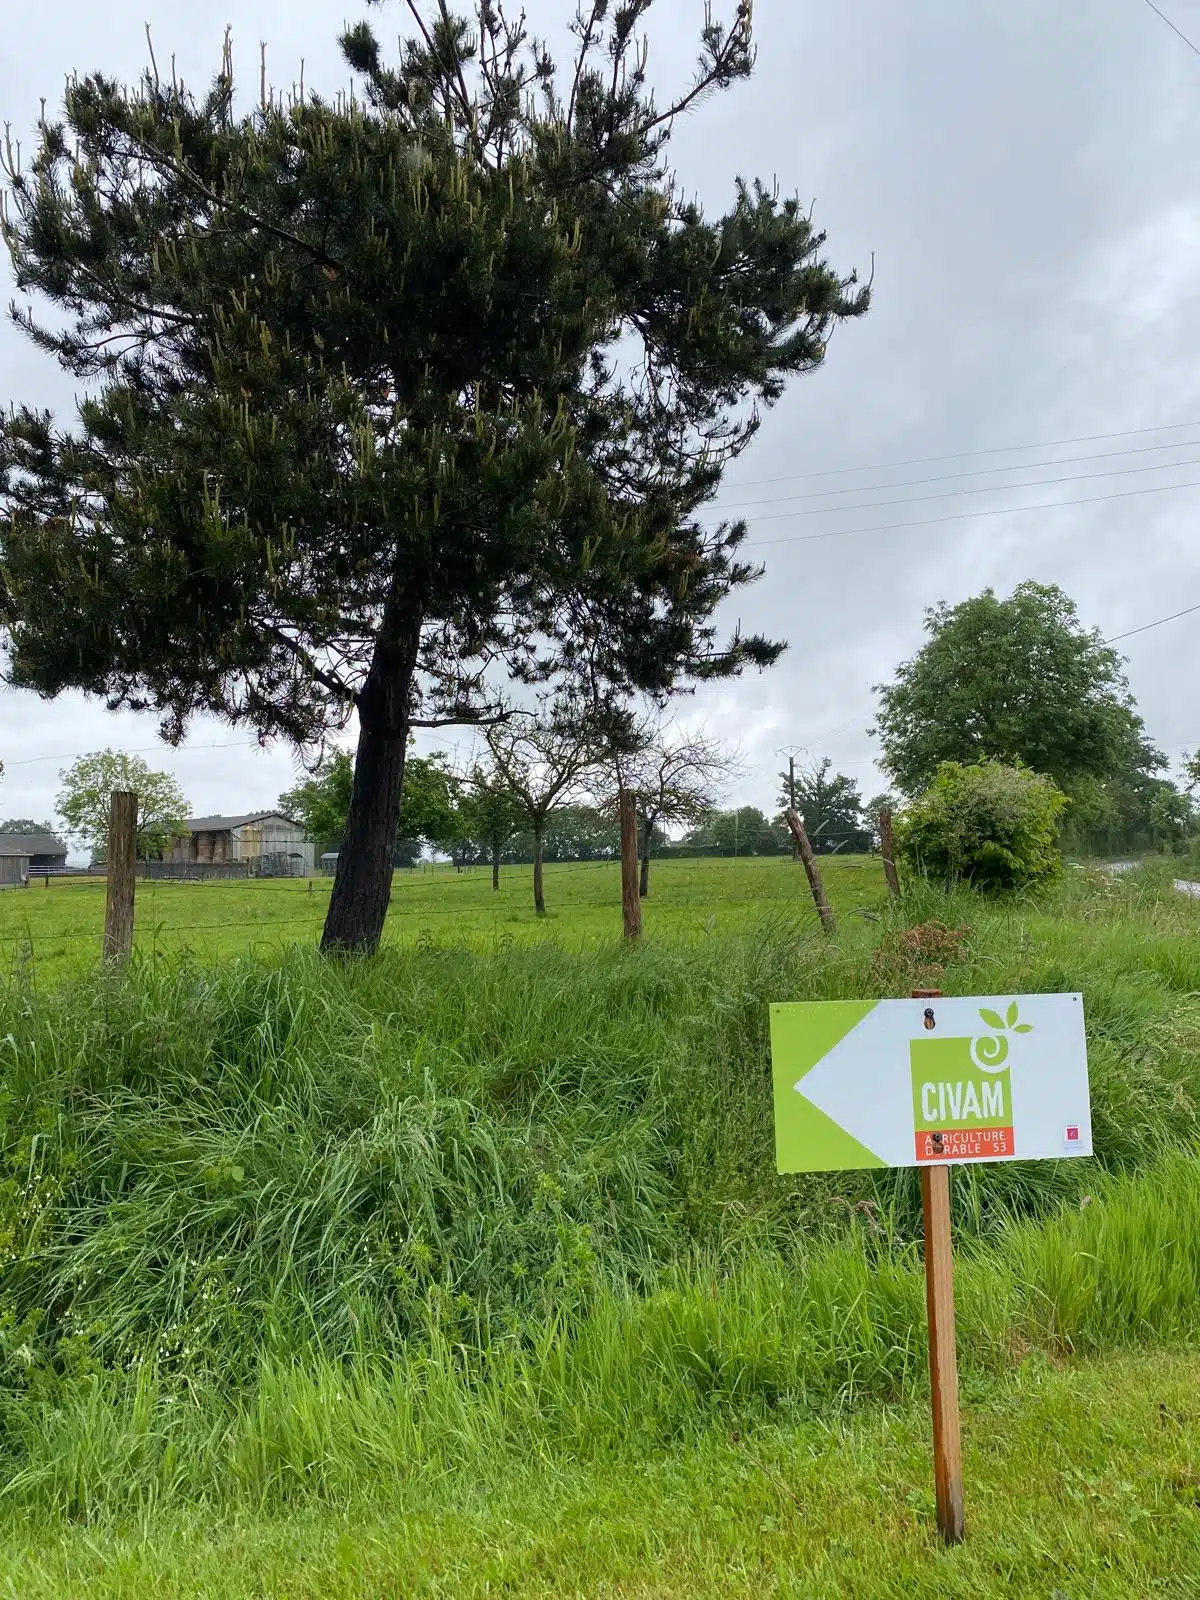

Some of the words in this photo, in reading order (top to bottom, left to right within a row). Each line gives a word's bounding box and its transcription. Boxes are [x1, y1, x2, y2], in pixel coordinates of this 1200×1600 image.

[921, 1080, 1004, 1122] CIVAM
[925, 1131, 1006, 1145] ARICULTURE
[925, 1143, 981, 1157] DRABLE
[993, 1142, 1007, 1153] 53
